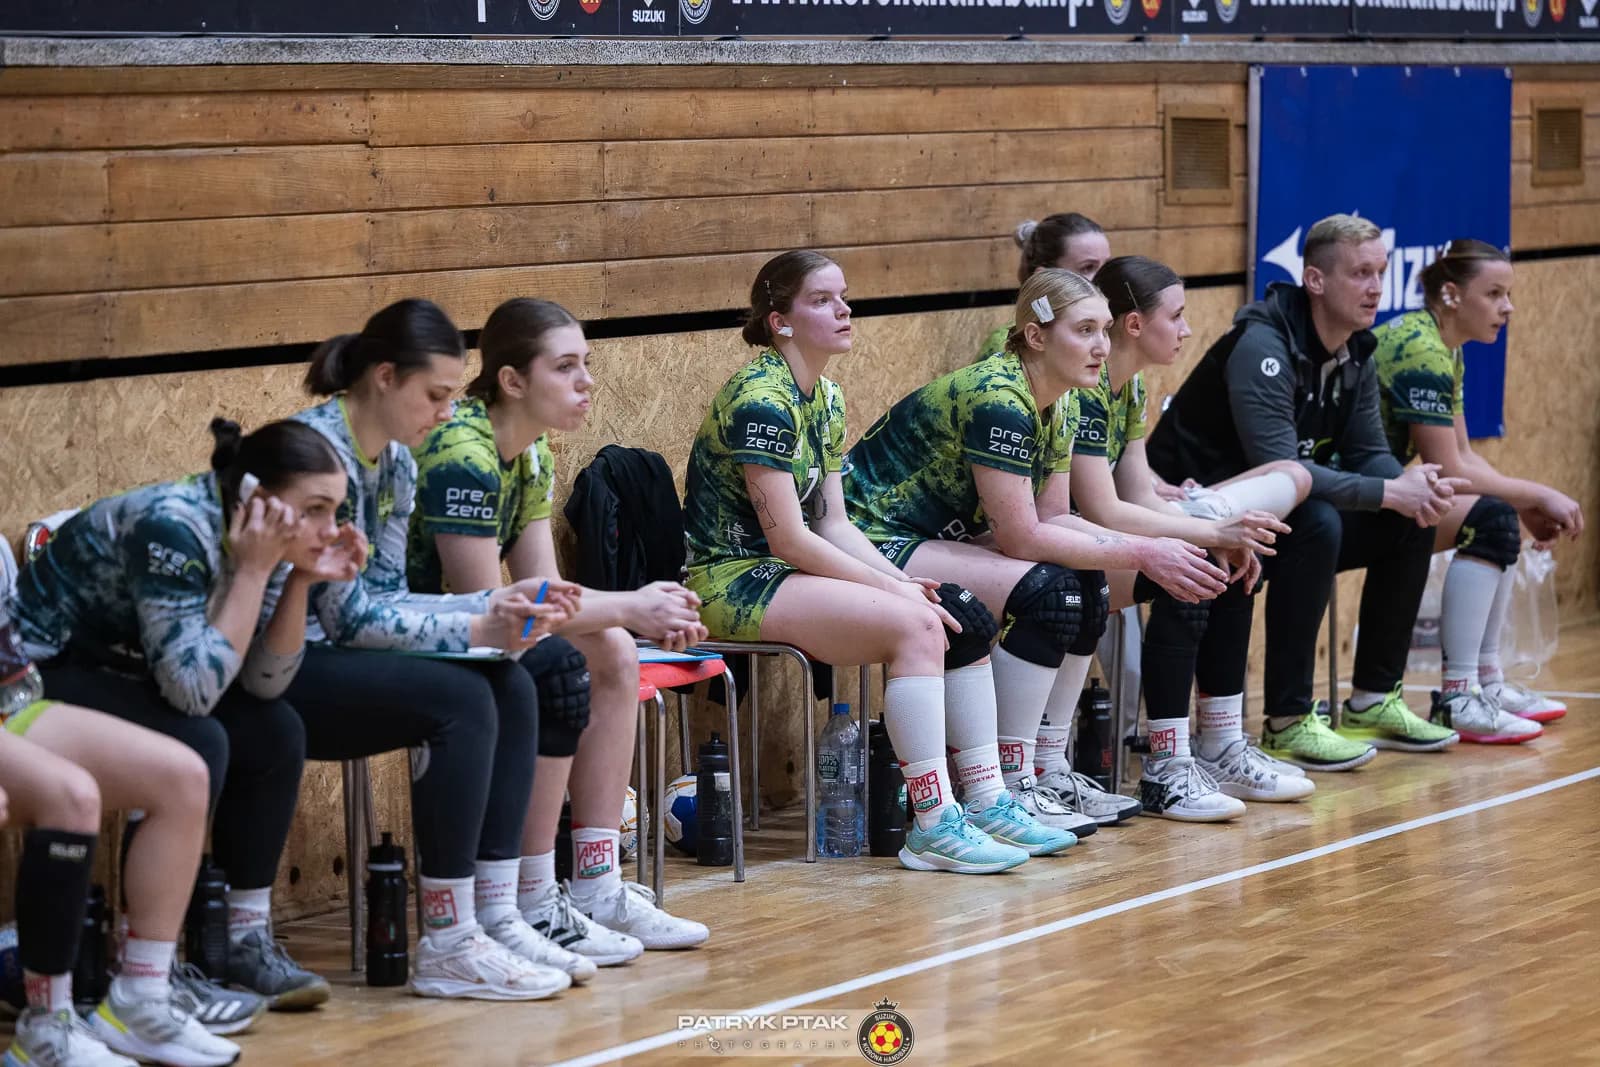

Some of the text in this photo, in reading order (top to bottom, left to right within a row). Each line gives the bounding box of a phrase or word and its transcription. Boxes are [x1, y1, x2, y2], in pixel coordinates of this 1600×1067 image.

[632, 10, 666, 22] SUZUKI
[746, 422, 778, 436] pre
[990, 427, 1023, 443] pre
[745, 437, 787, 453] zero
[988, 440, 1030, 459] zero
[446, 487, 485, 503] pre
[445, 503, 494, 519] zero
